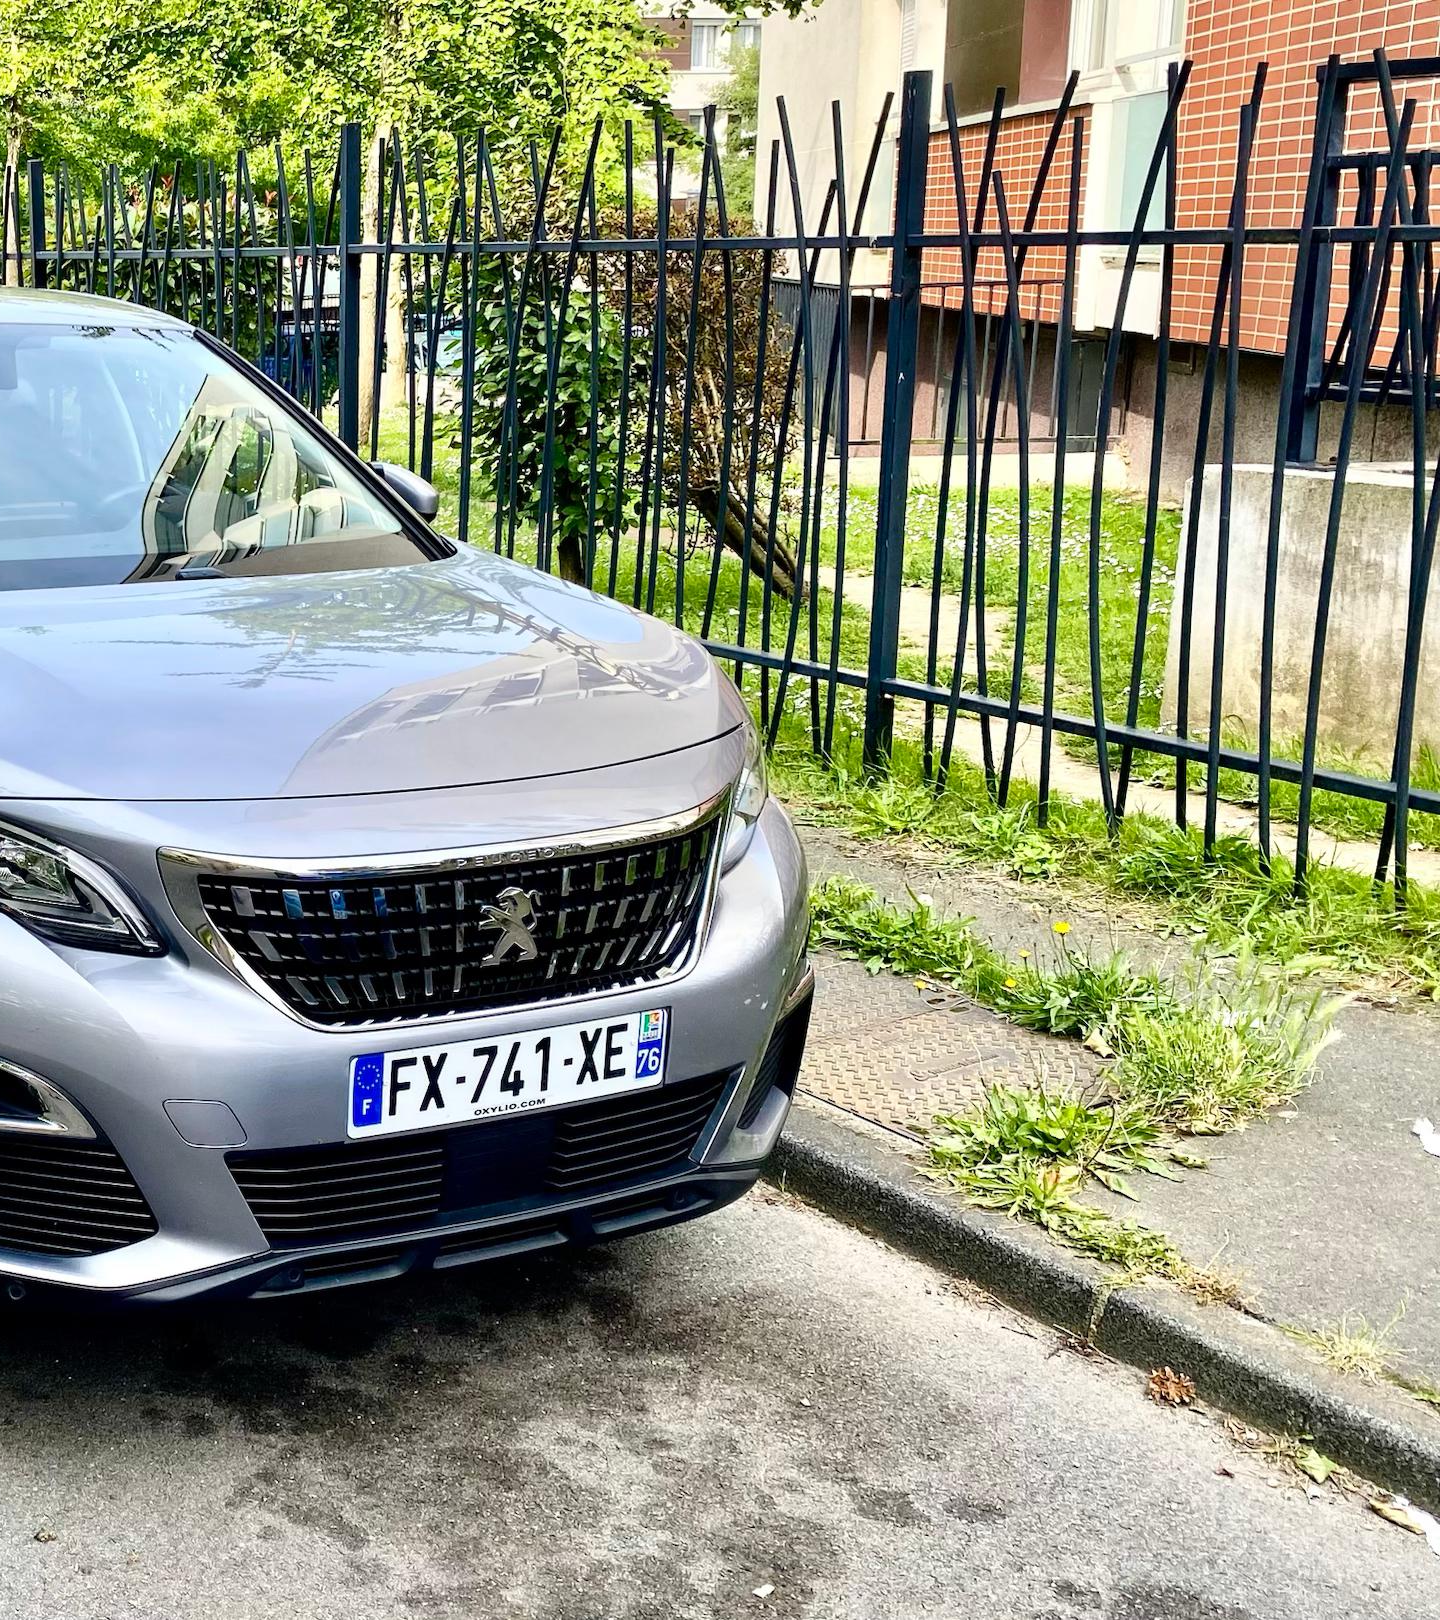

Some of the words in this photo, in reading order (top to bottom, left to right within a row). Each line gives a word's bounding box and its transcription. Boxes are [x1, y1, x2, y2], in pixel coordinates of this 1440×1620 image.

[456, 845, 574, 869] PEUGEOT
[388, 1023, 628, 1116] FX-741-XE
[637, 1047, 660, 1074] 76
[362, 1098, 372, 1115] F
[474, 1098, 546, 1116] OXYLIO.COM
